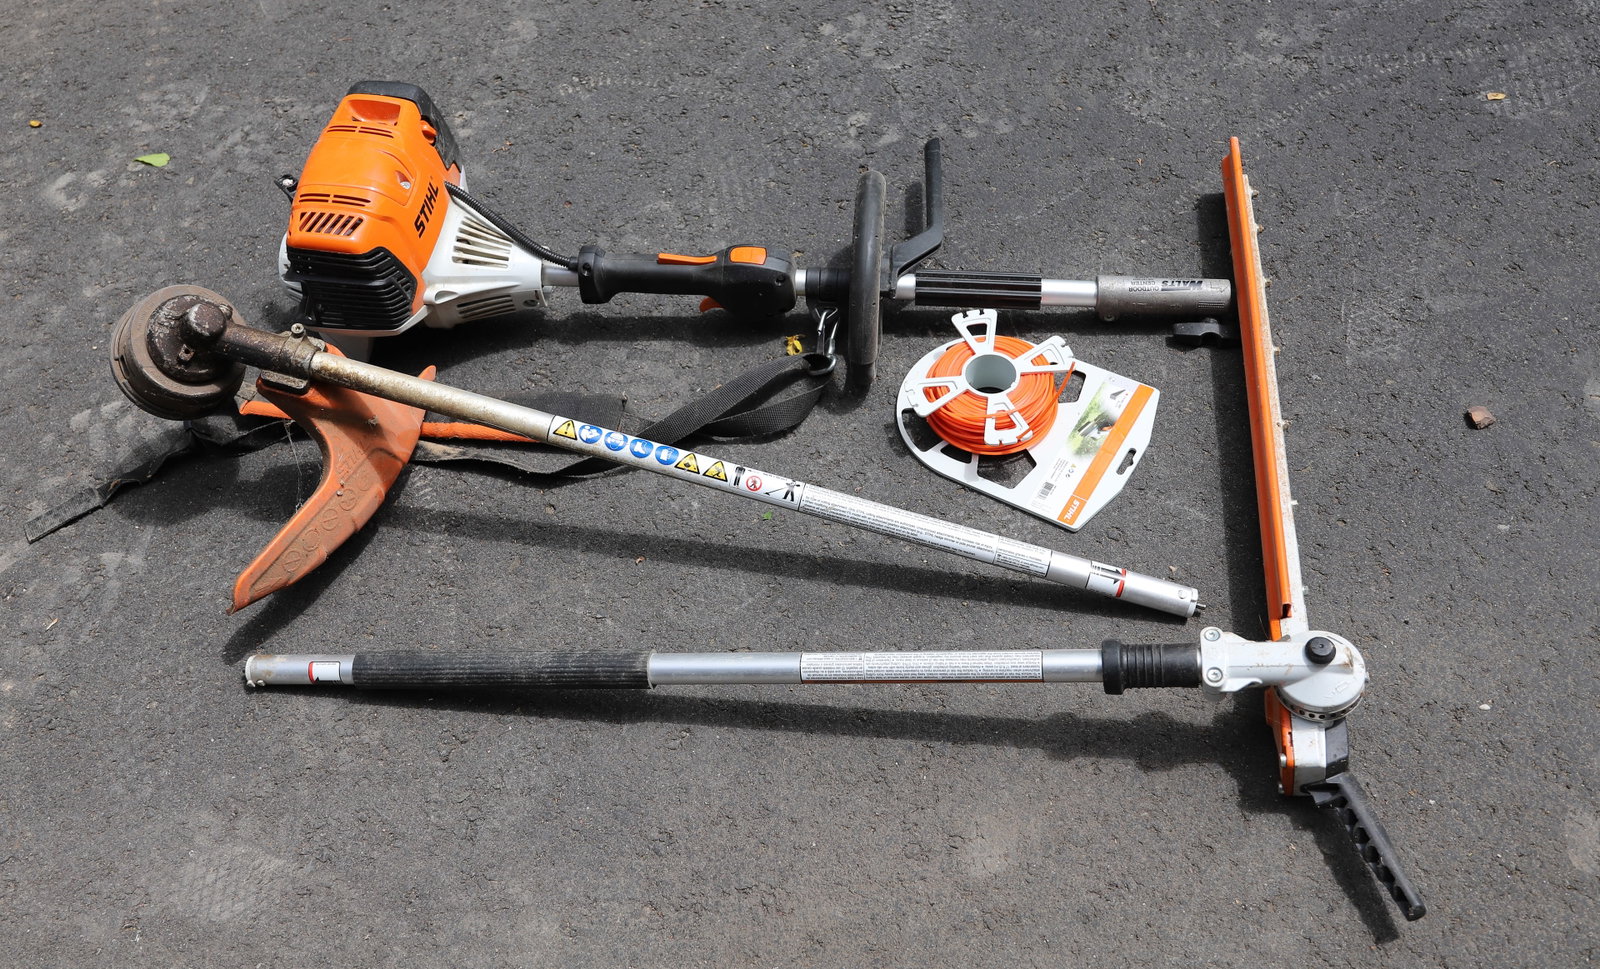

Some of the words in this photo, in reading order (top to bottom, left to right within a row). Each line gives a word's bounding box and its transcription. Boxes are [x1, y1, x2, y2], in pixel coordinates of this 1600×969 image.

[414, 182, 439, 239] STIHL
[1161, 280, 1203, 292] WALTS
[1064, 499, 1080, 520] STIHL
